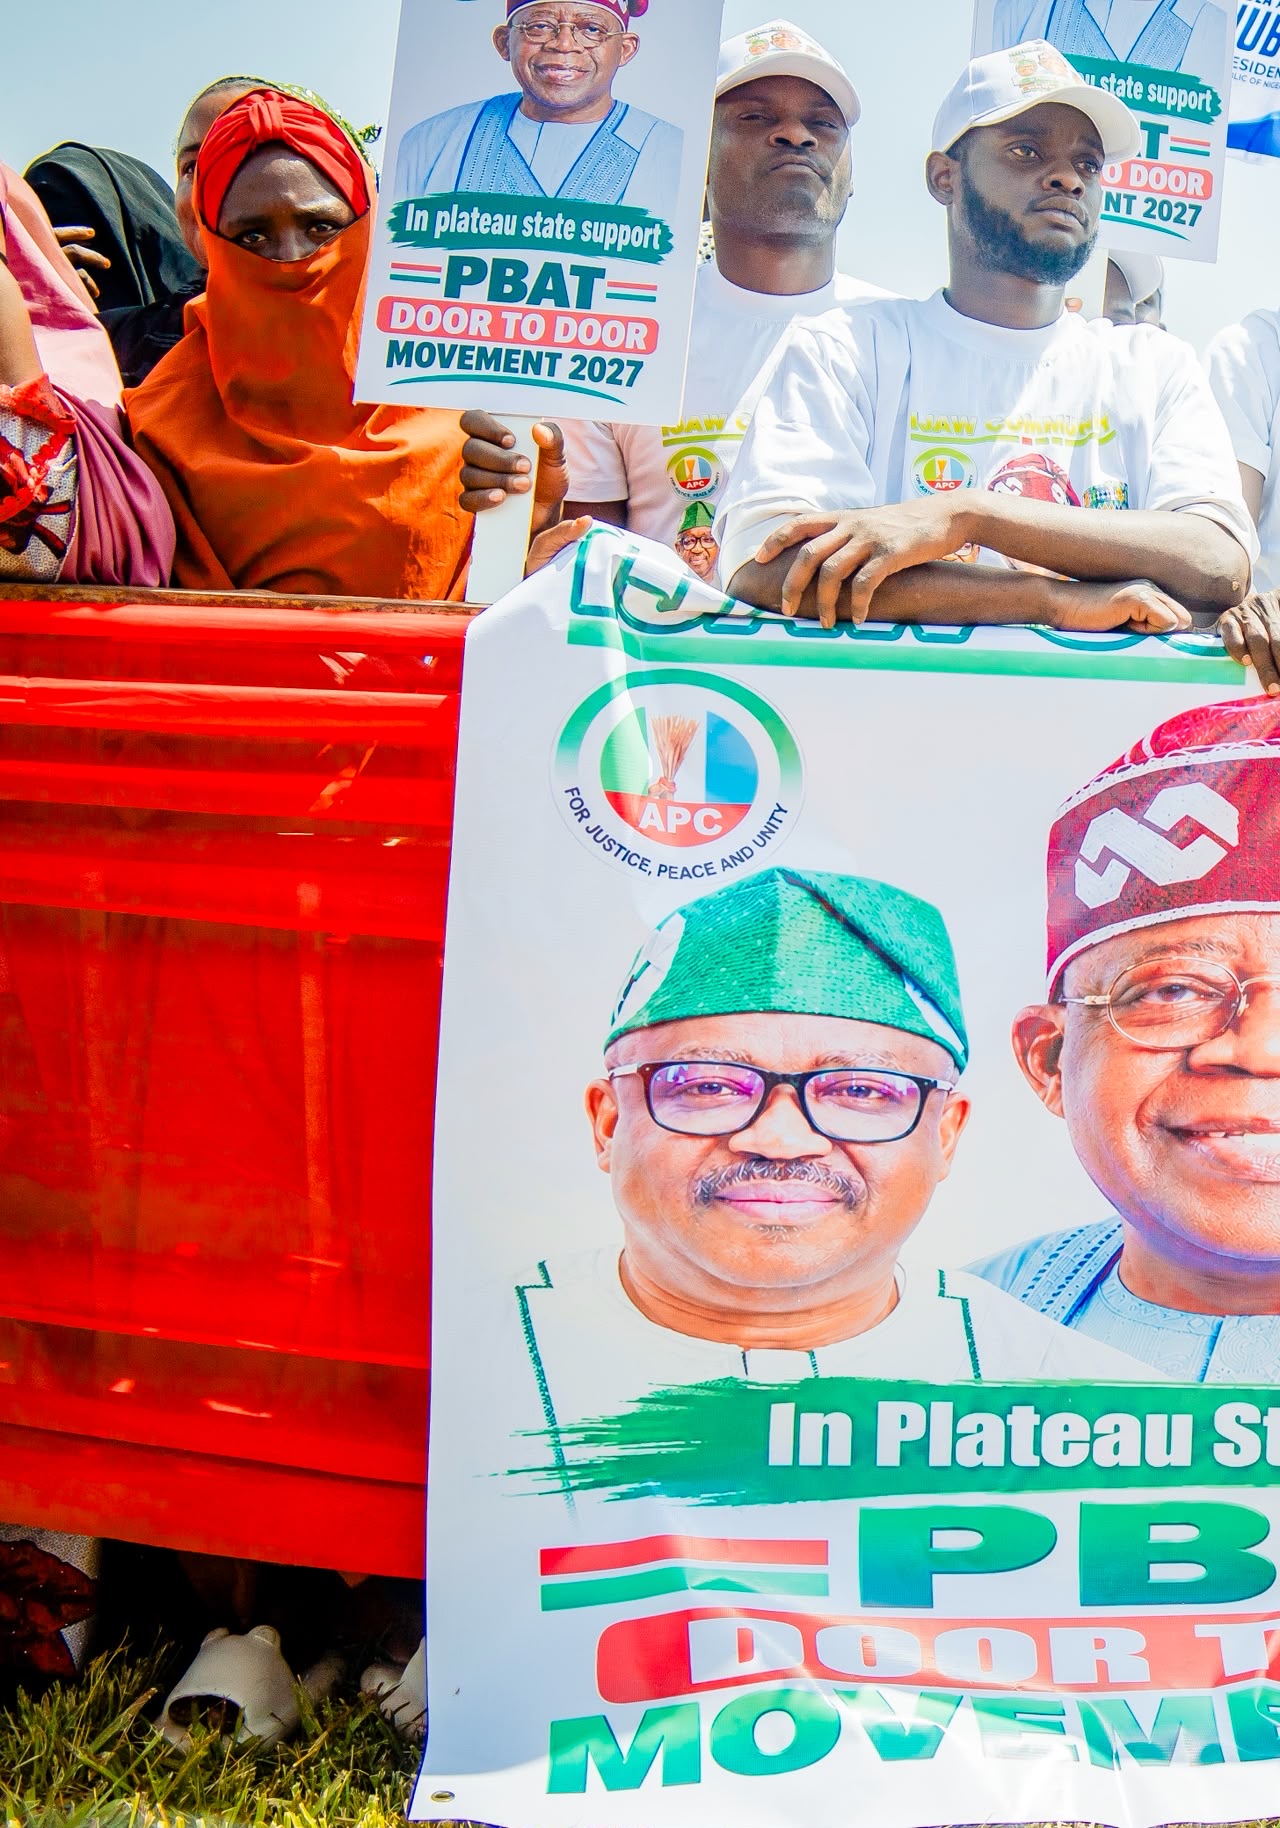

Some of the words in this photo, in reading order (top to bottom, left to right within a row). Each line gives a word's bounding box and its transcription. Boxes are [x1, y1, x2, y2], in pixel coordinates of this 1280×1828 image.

[1100, 73, 1144, 99] state
[1148, 83, 1213, 113] support
[1249, 77, 1262, 86] OF
[1130, 163, 1204, 196] DOOR
[405, 203, 428, 231] In
[434, 204, 515, 238] plateau
[521, 209, 575, 240] state
[581, 220, 662, 252] support
[1143, 196, 1202, 227] 2027
[443, 255, 606, 310] PBAT
[390, 302, 491, 338] DOOR
[502, 311, 546, 342] TO
[554, 315, 648, 350] DOOR
[386, 340, 562, 377] MOVEMENT
[568, 355, 644, 387] 2027
[910, 411, 977, 436] IJAW
[686, 481, 705, 489] APC
[565, 786, 590, 823] FOR
[586, 824, 652, 876] JUSTICE,
[657, 862, 717, 880] PEACE
[721, 845, 755, 872] AND
[751, 802, 789, 848] UNITY
[639, 802, 723, 835] APC
[767, 1401, 852, 1468] In
[875, 1400, 1194, 1469] Plateau
[688, 1616, 1150, 1684] DOOR
